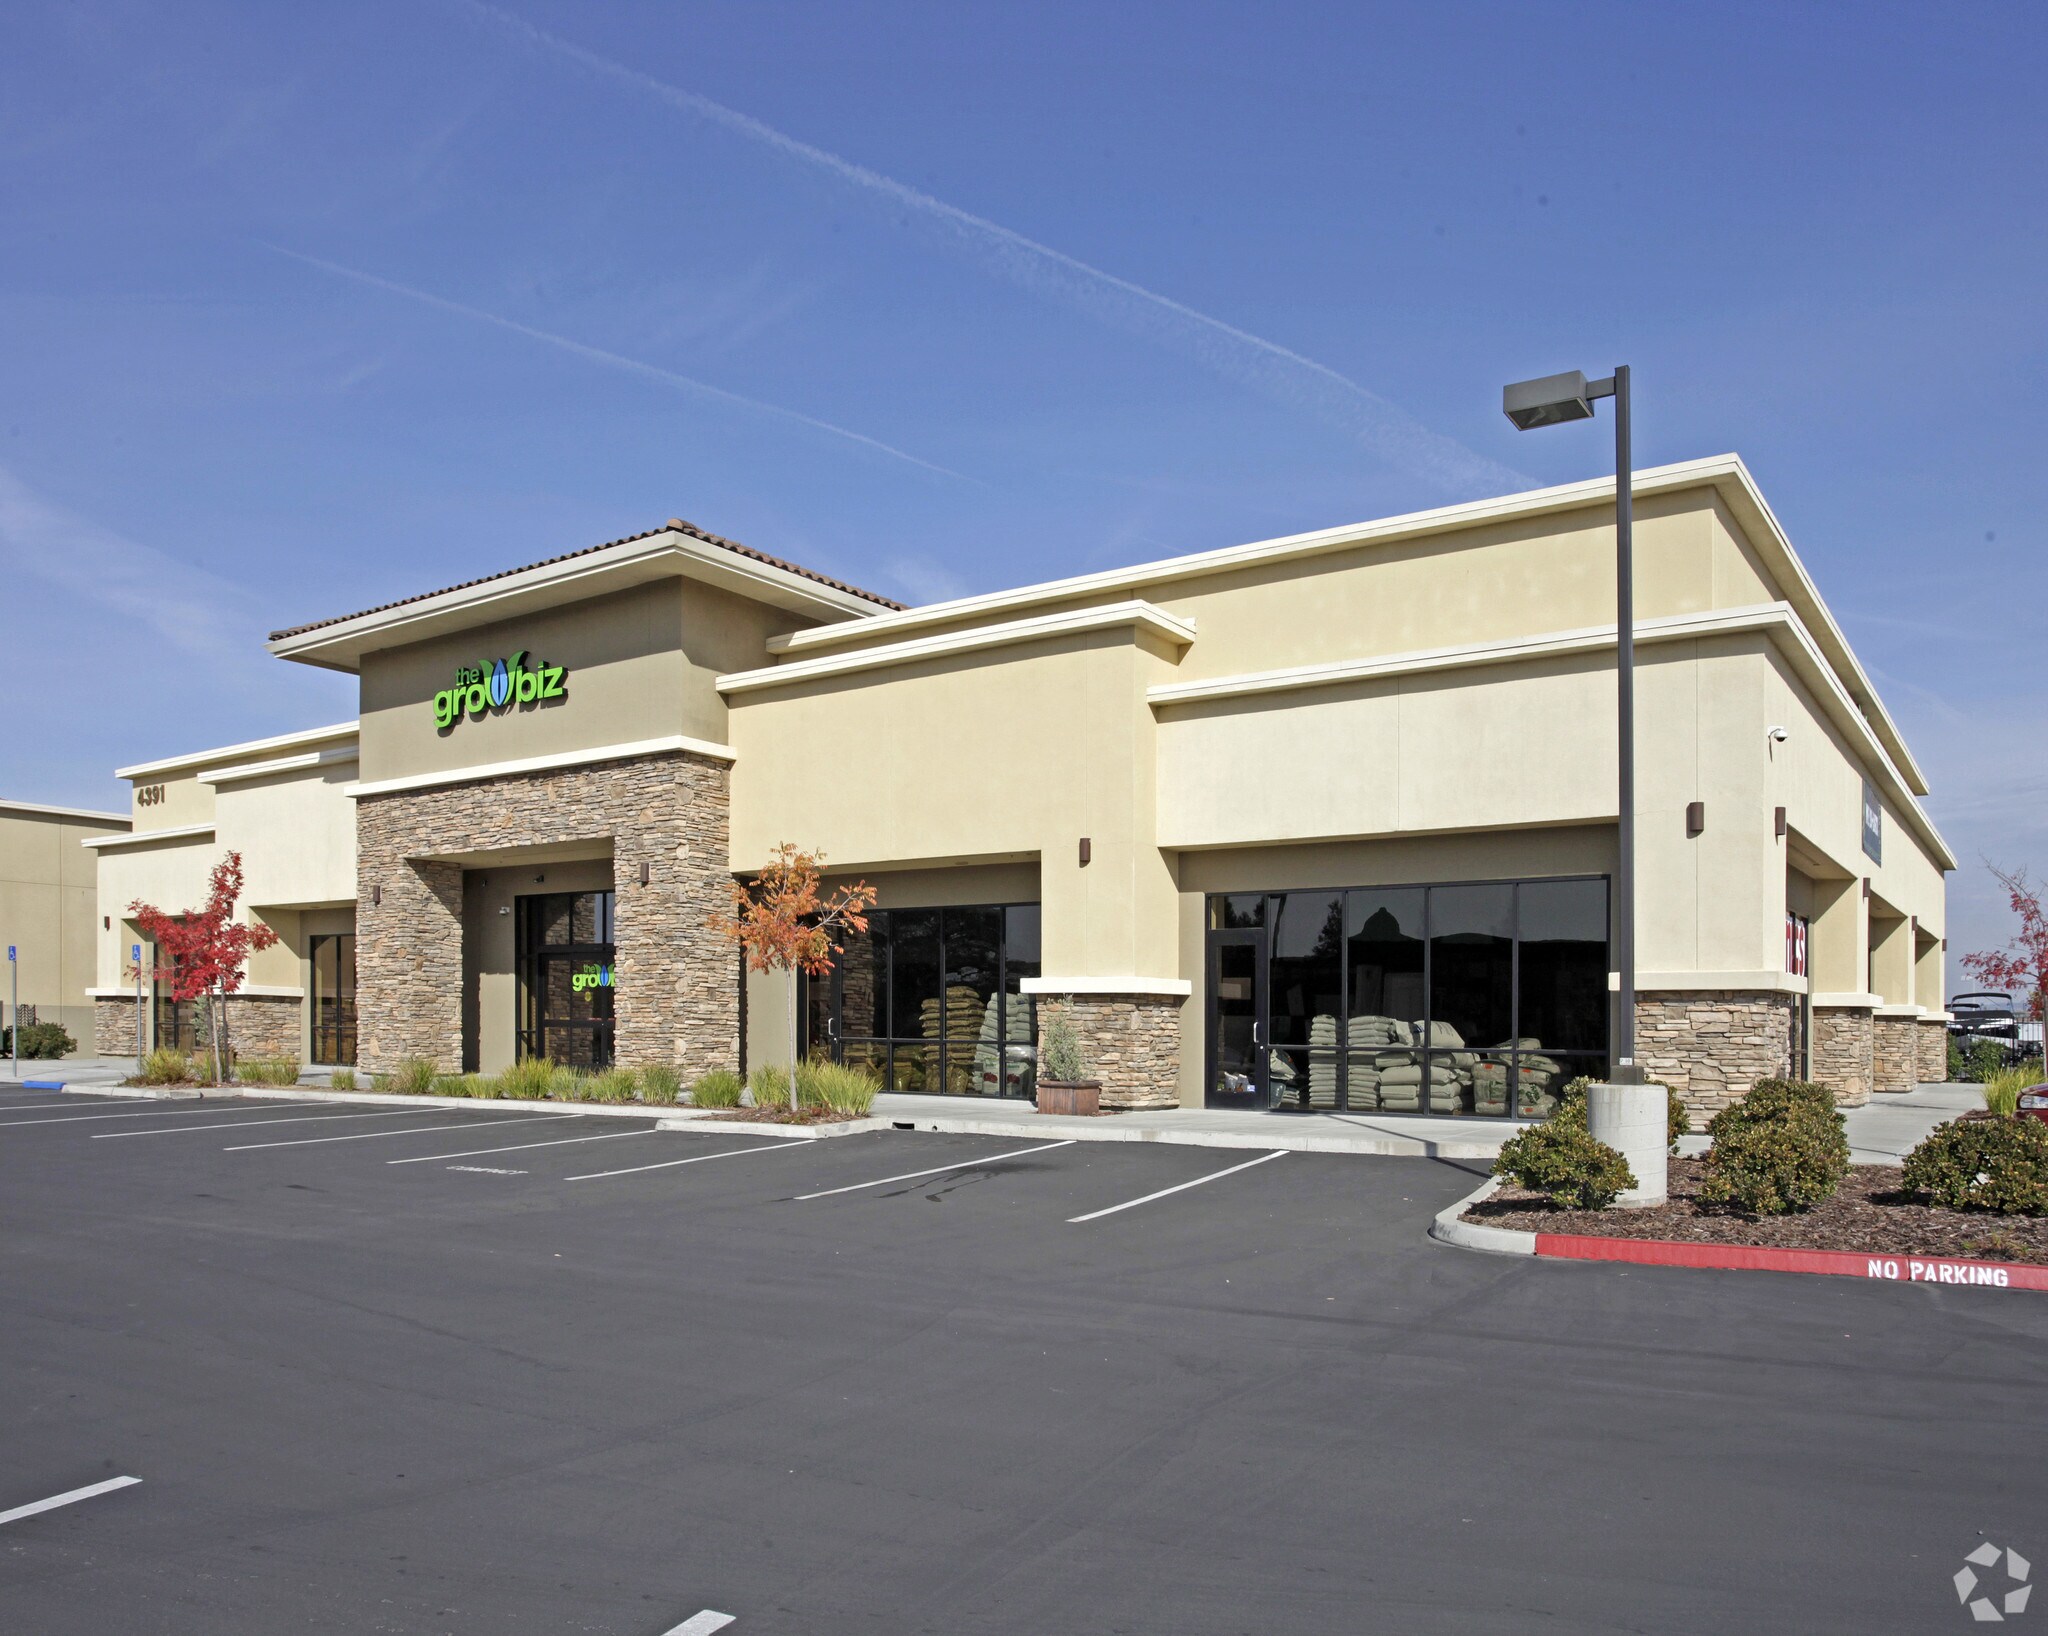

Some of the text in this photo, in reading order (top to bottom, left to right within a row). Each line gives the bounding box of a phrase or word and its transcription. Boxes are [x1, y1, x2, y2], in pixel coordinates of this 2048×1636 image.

[455, 667, 480, 686] the
[137, 784, 165, 807] 4391
[583, 963, 596, 974] the
[1868, 1259, 2008, 1287] NO PARKING
